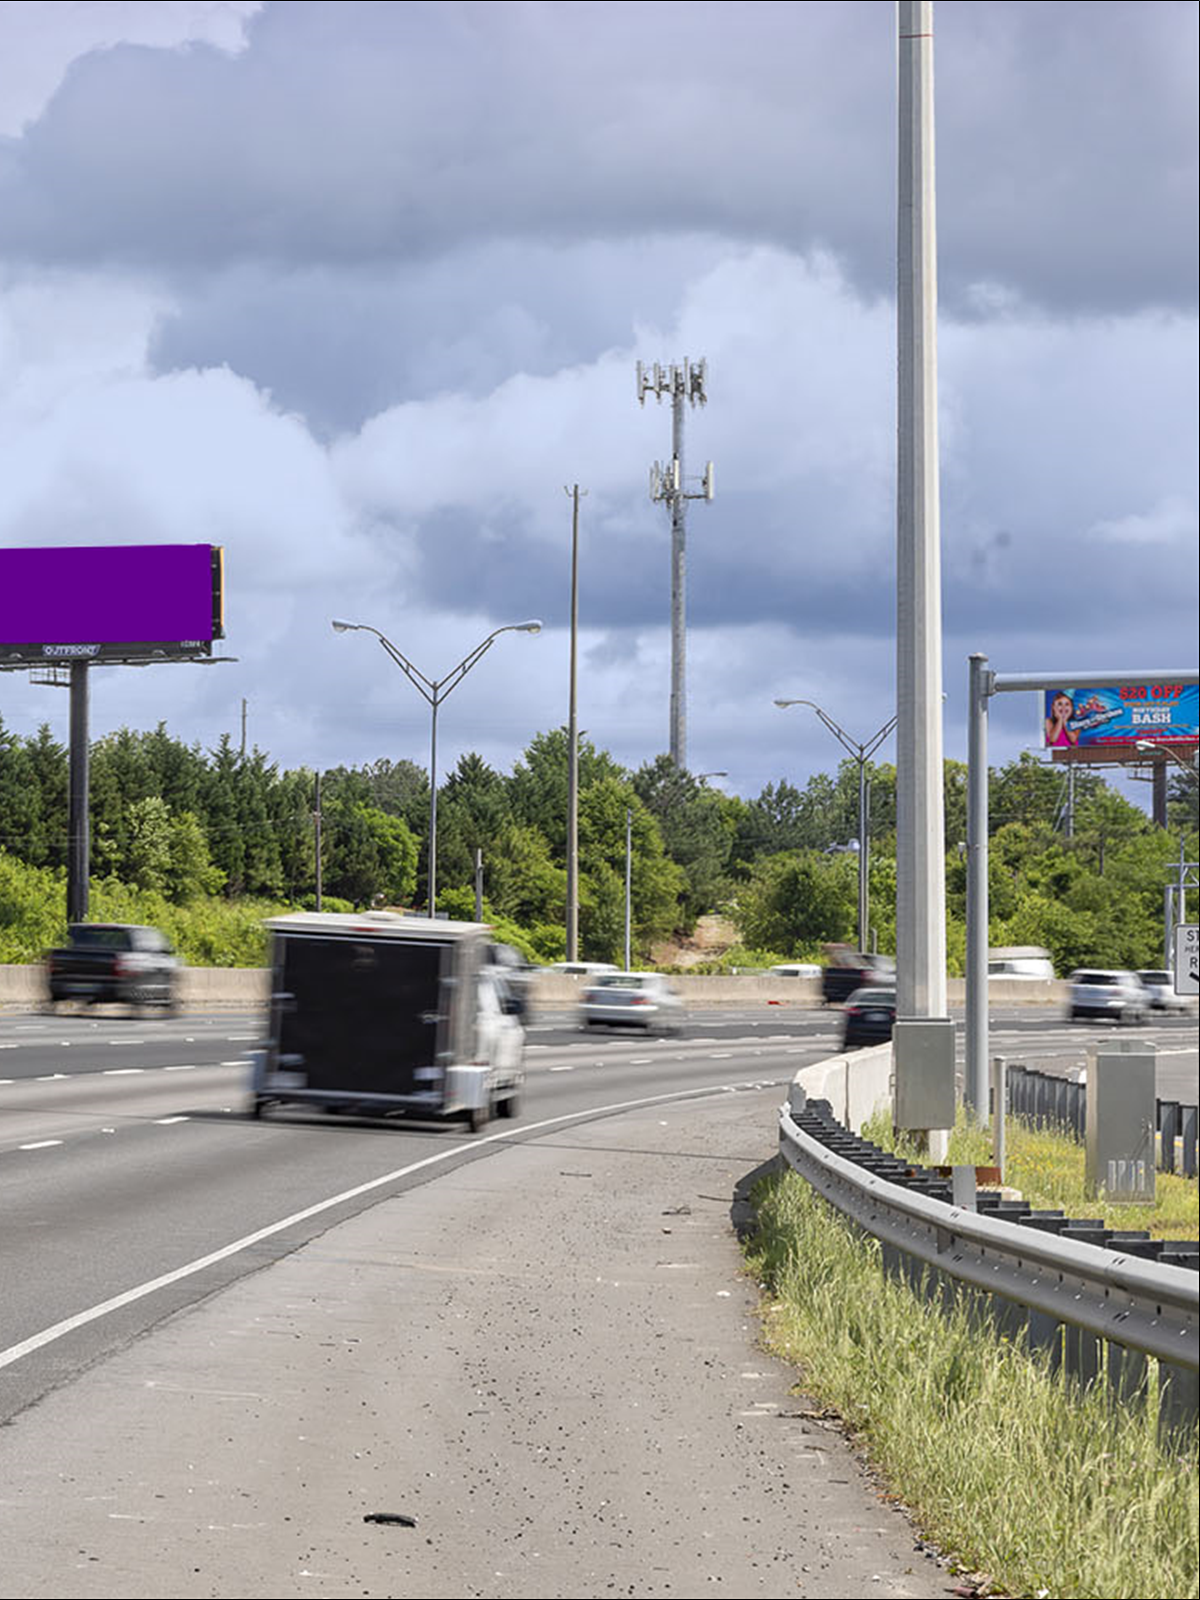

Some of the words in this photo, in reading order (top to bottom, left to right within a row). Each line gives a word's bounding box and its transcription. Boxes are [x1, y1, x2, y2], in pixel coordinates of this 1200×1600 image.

[45, 645, 97, 656] OUTFRONT
[1120, 686, 1147, 699] $20
[1151, 685, 1183, 698] OFF
[1132, 713, 1171, 724] BASH
